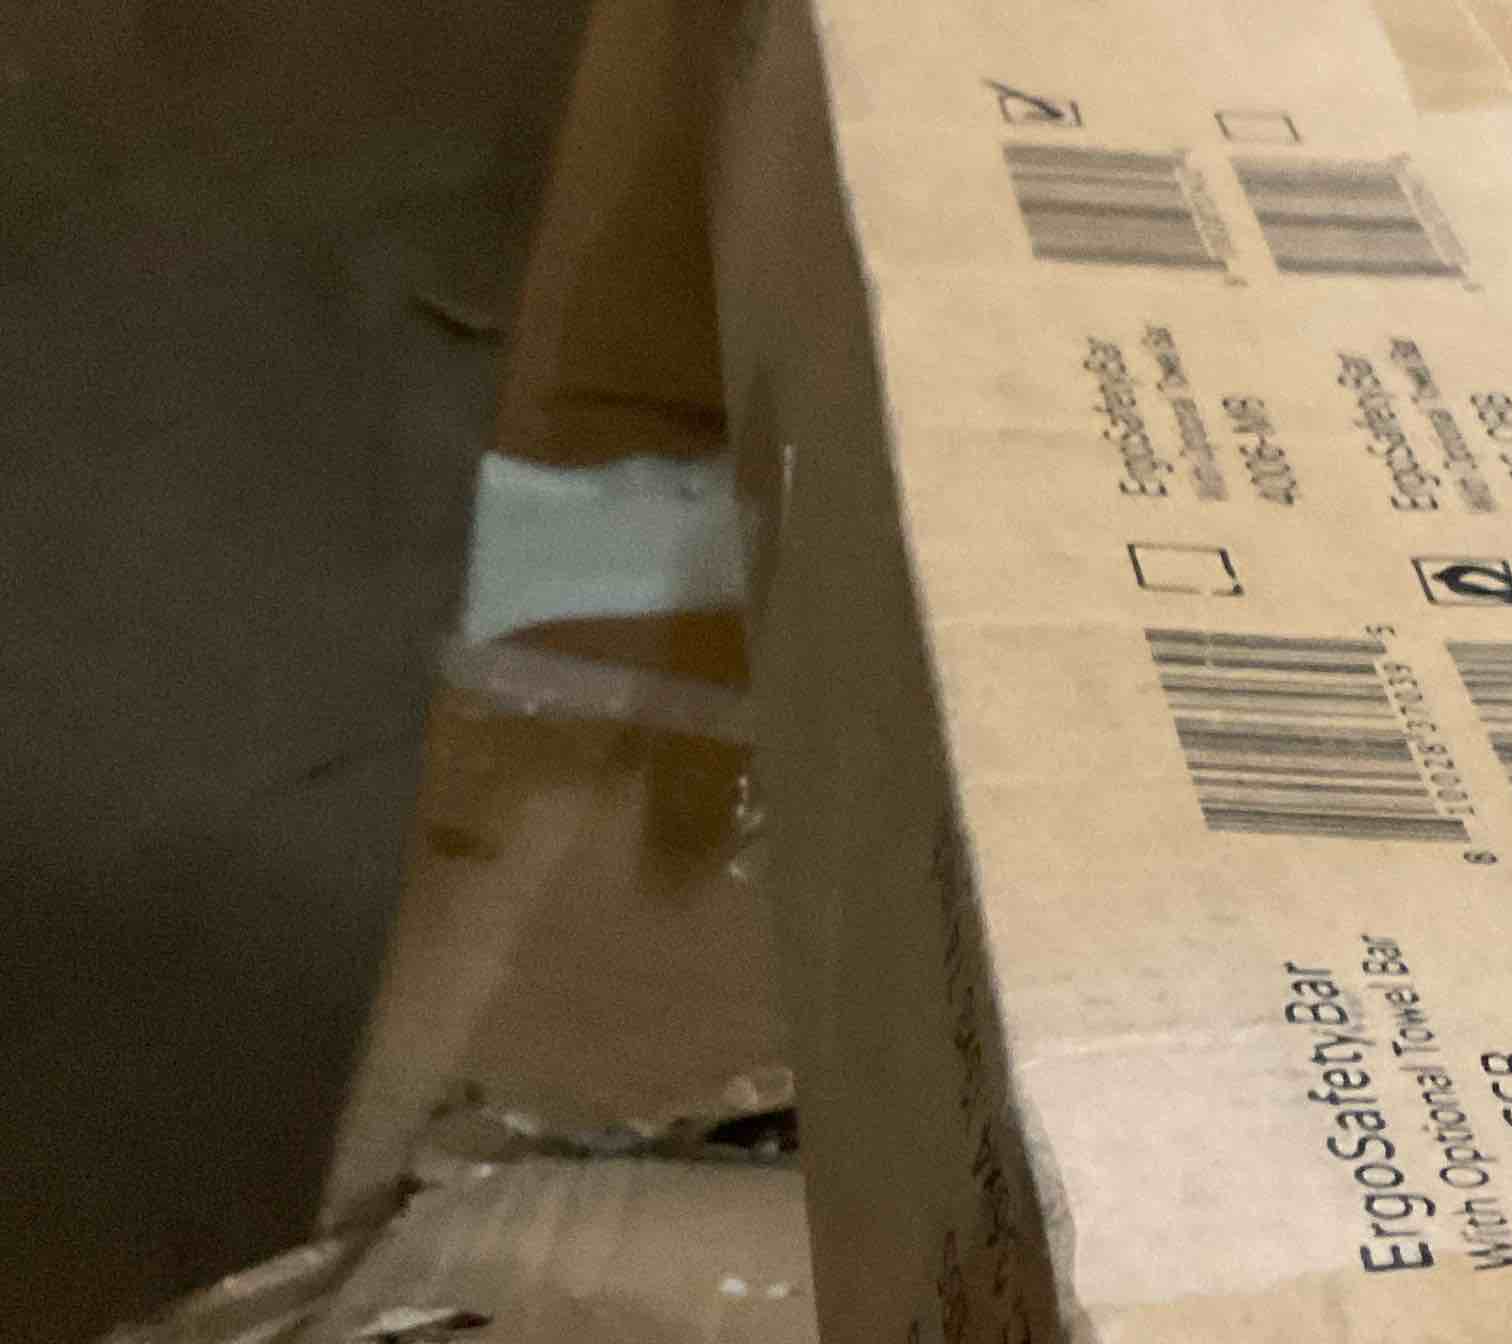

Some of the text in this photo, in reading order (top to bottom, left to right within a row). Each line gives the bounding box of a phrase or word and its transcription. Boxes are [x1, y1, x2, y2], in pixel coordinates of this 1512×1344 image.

[1360, 934, 1410, 976] Bar
[1362, 979, 1440, 1057] Towel
[1284, 961, 1436, 1272] ErgoSafetyBar
[1399, 1063, 1499, 1189] Optional
